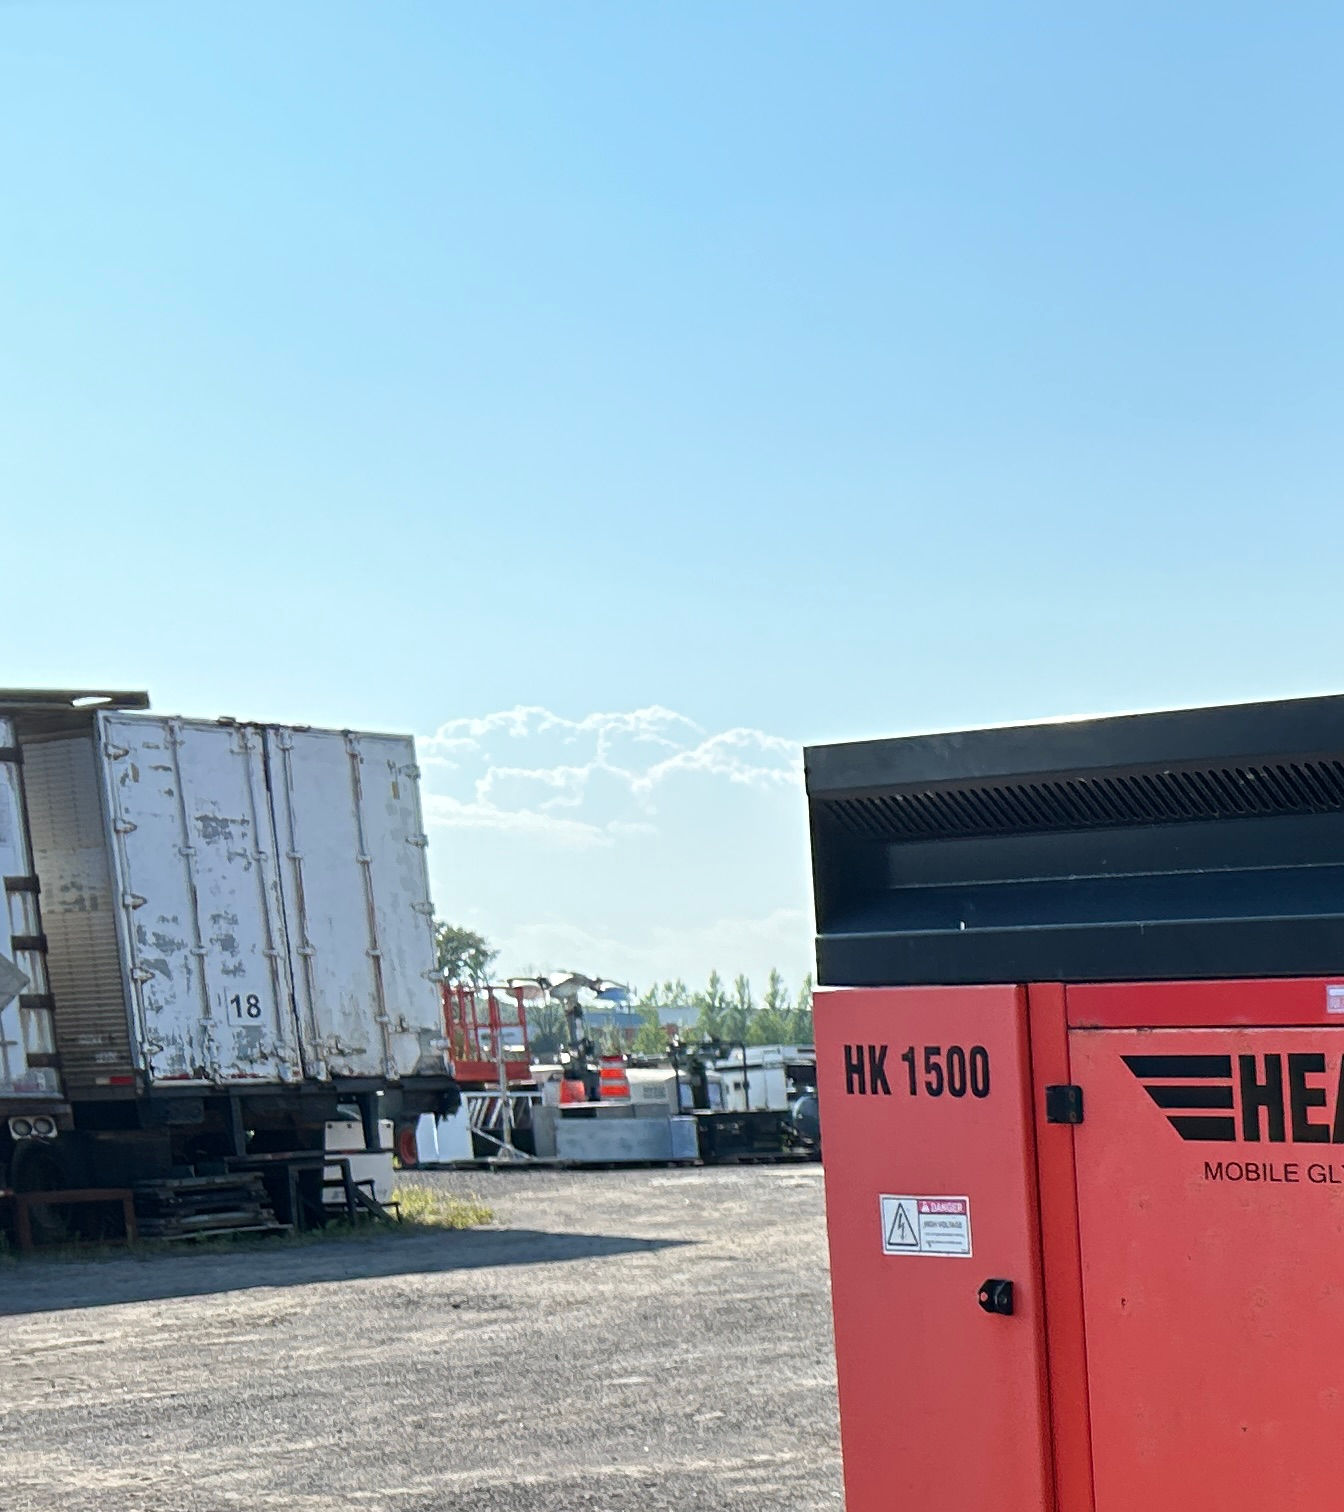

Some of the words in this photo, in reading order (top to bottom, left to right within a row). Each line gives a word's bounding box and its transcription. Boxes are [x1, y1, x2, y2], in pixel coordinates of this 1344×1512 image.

[230, 993, 261, 1018] 18
[844, 1044, 892, 1096] HK
[901, 1045, 990, 1099] 1500
[1203, 1161, 1299, 1184] MOBILE
[930, 1202, 963, 1213] DANGER
